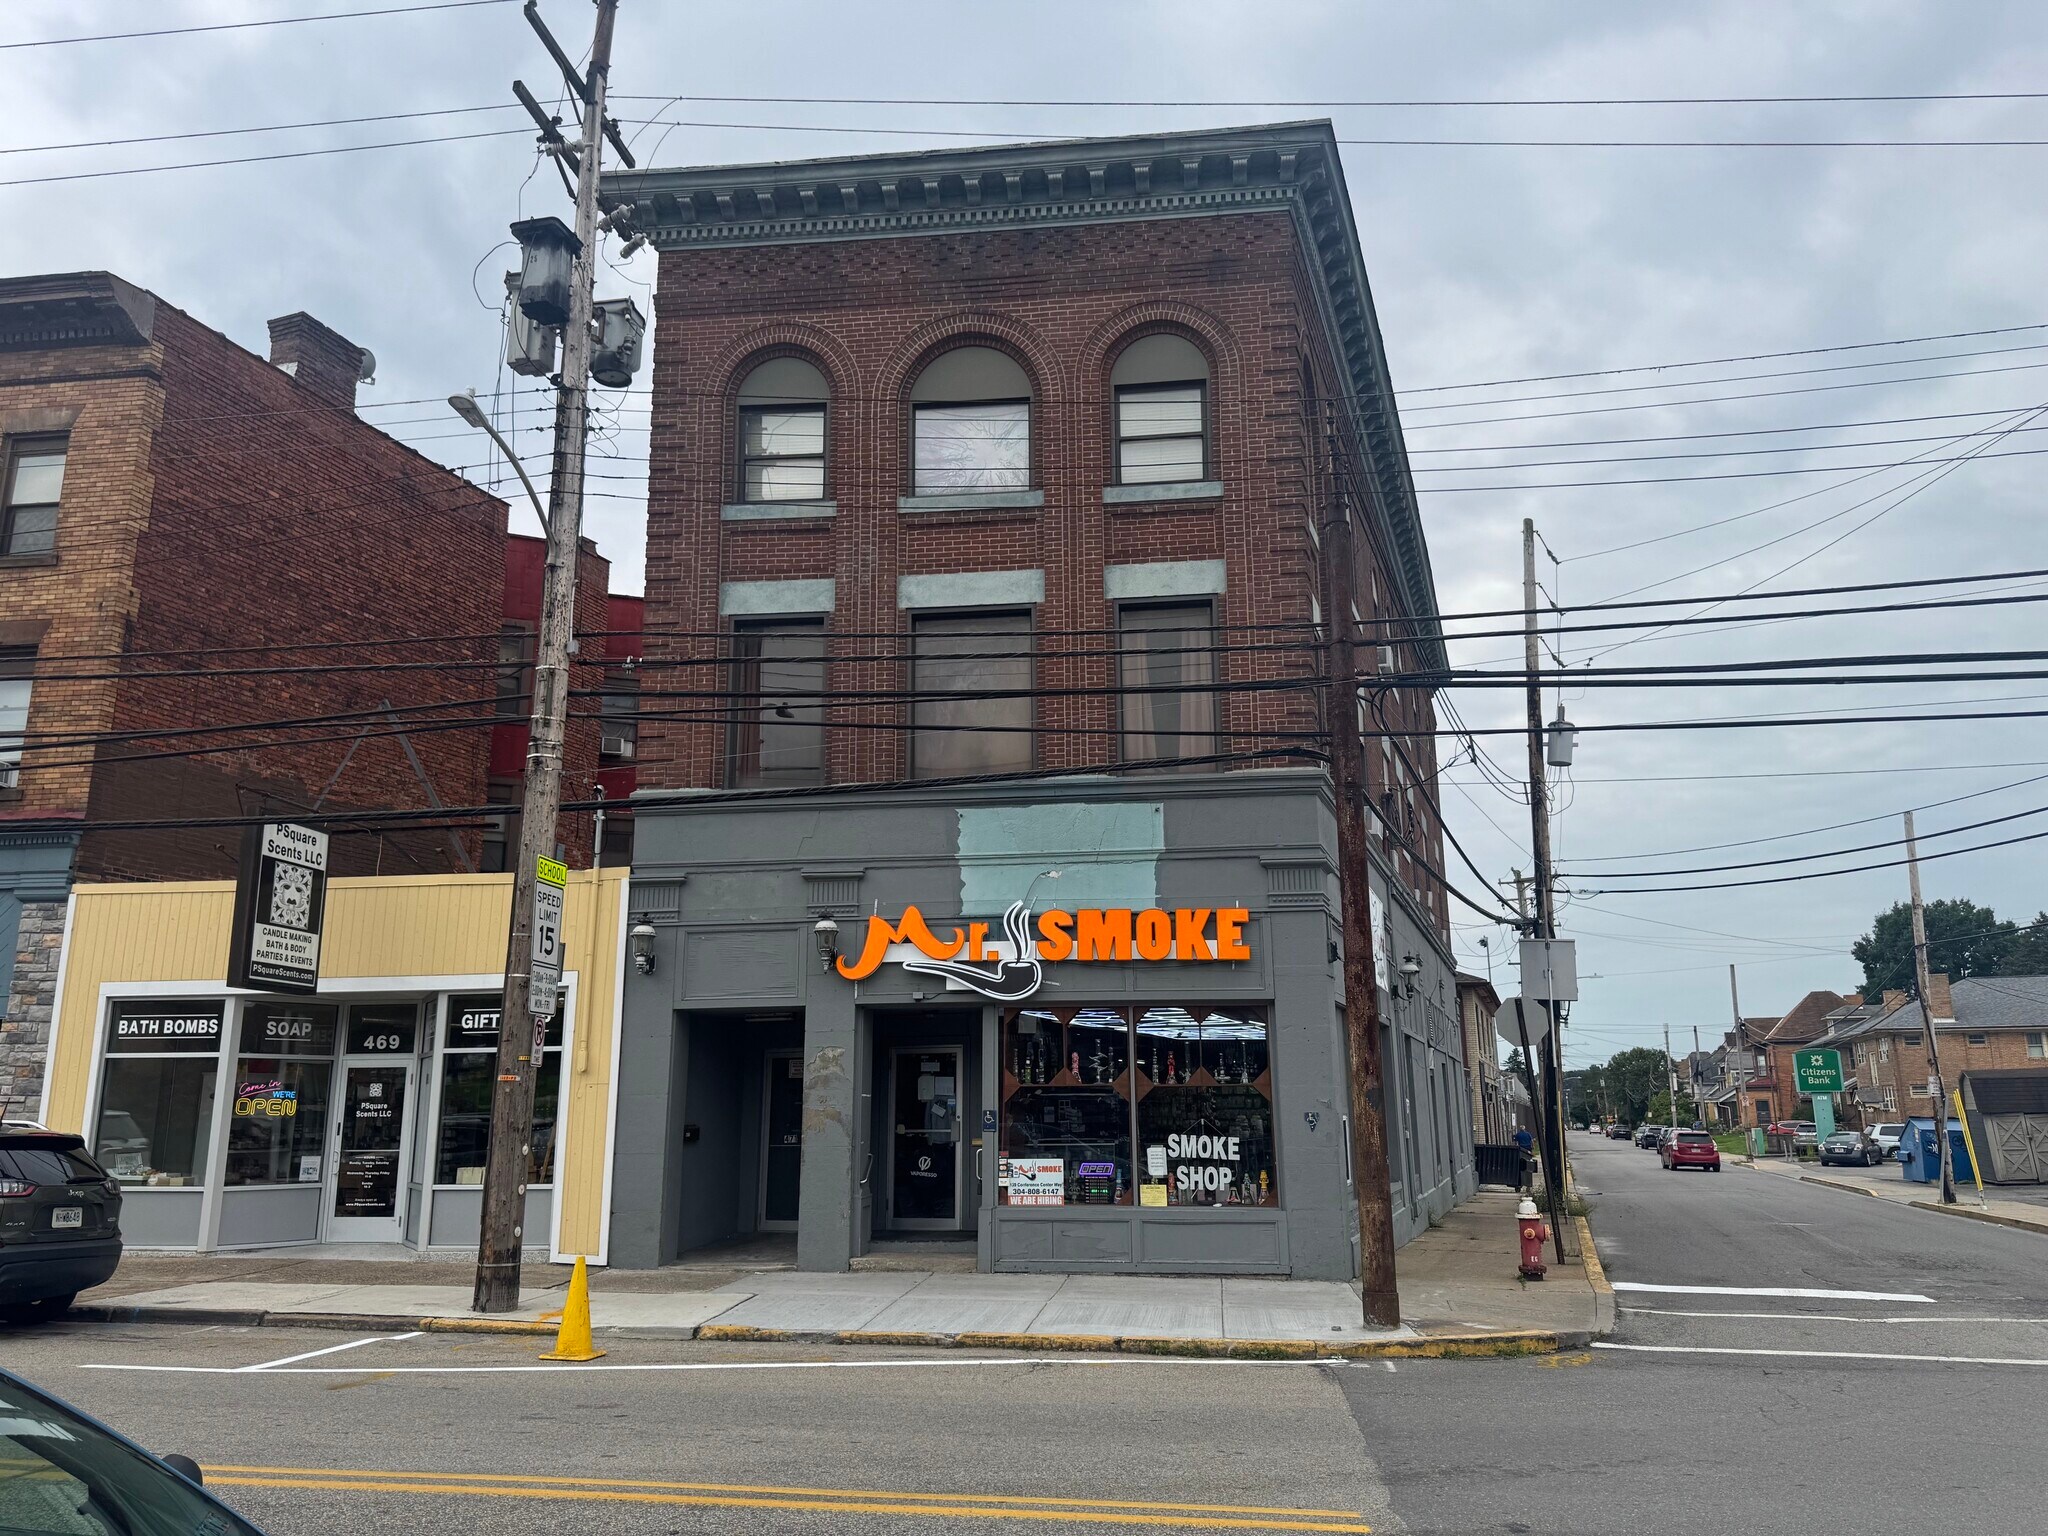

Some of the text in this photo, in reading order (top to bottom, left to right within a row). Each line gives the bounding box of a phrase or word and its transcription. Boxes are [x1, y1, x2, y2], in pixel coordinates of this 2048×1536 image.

[276, 824, 317, 846] PSquare
[268, 839, 322, 866] Scents LLC
[539, 862, 564, 881] SCHOOL
[537, 891, 560, 908] SPEED
[539, 908, 557, 923] LIMIT
[262, 928, 312, 944] CANDLE MAKING
[539, 925, 554, 955] 15
[836, 904, 1251, 980] Mr. SMOKE
[266, 940, 284, 950] BATH
[290, 944, 307, 954] BODY
[256, 950, 283, 962] PARTIES
[290, 955, 313, 966] EVENTS
[253, 964, 313, 980] PSquareScents.com
[118, 1019, 218, 1034] BATH BOMBS
[266, 1021, 312, 1036] SOAP
[461, 1014, 500, 1028] GIFT
[364, 1035, 400, 1050] 469
[1800, 1068, 1836, 1076] Citizens
[1808, 1076, 1830, 1084] Bank
[239, 1082, 266, 1094] Come
[236, 1098, 297, 1116] OPEN
[1167, 1134, 1240, 1160] SMOKE
[910, 1170, 937, 1178] VAPORESSO
[1176, 1165, 1232, 1190] SHOP
[68, 1189, 84, 1198] Jeep
[1010, 1196, 1062, 1204] WE ARE HIRING
